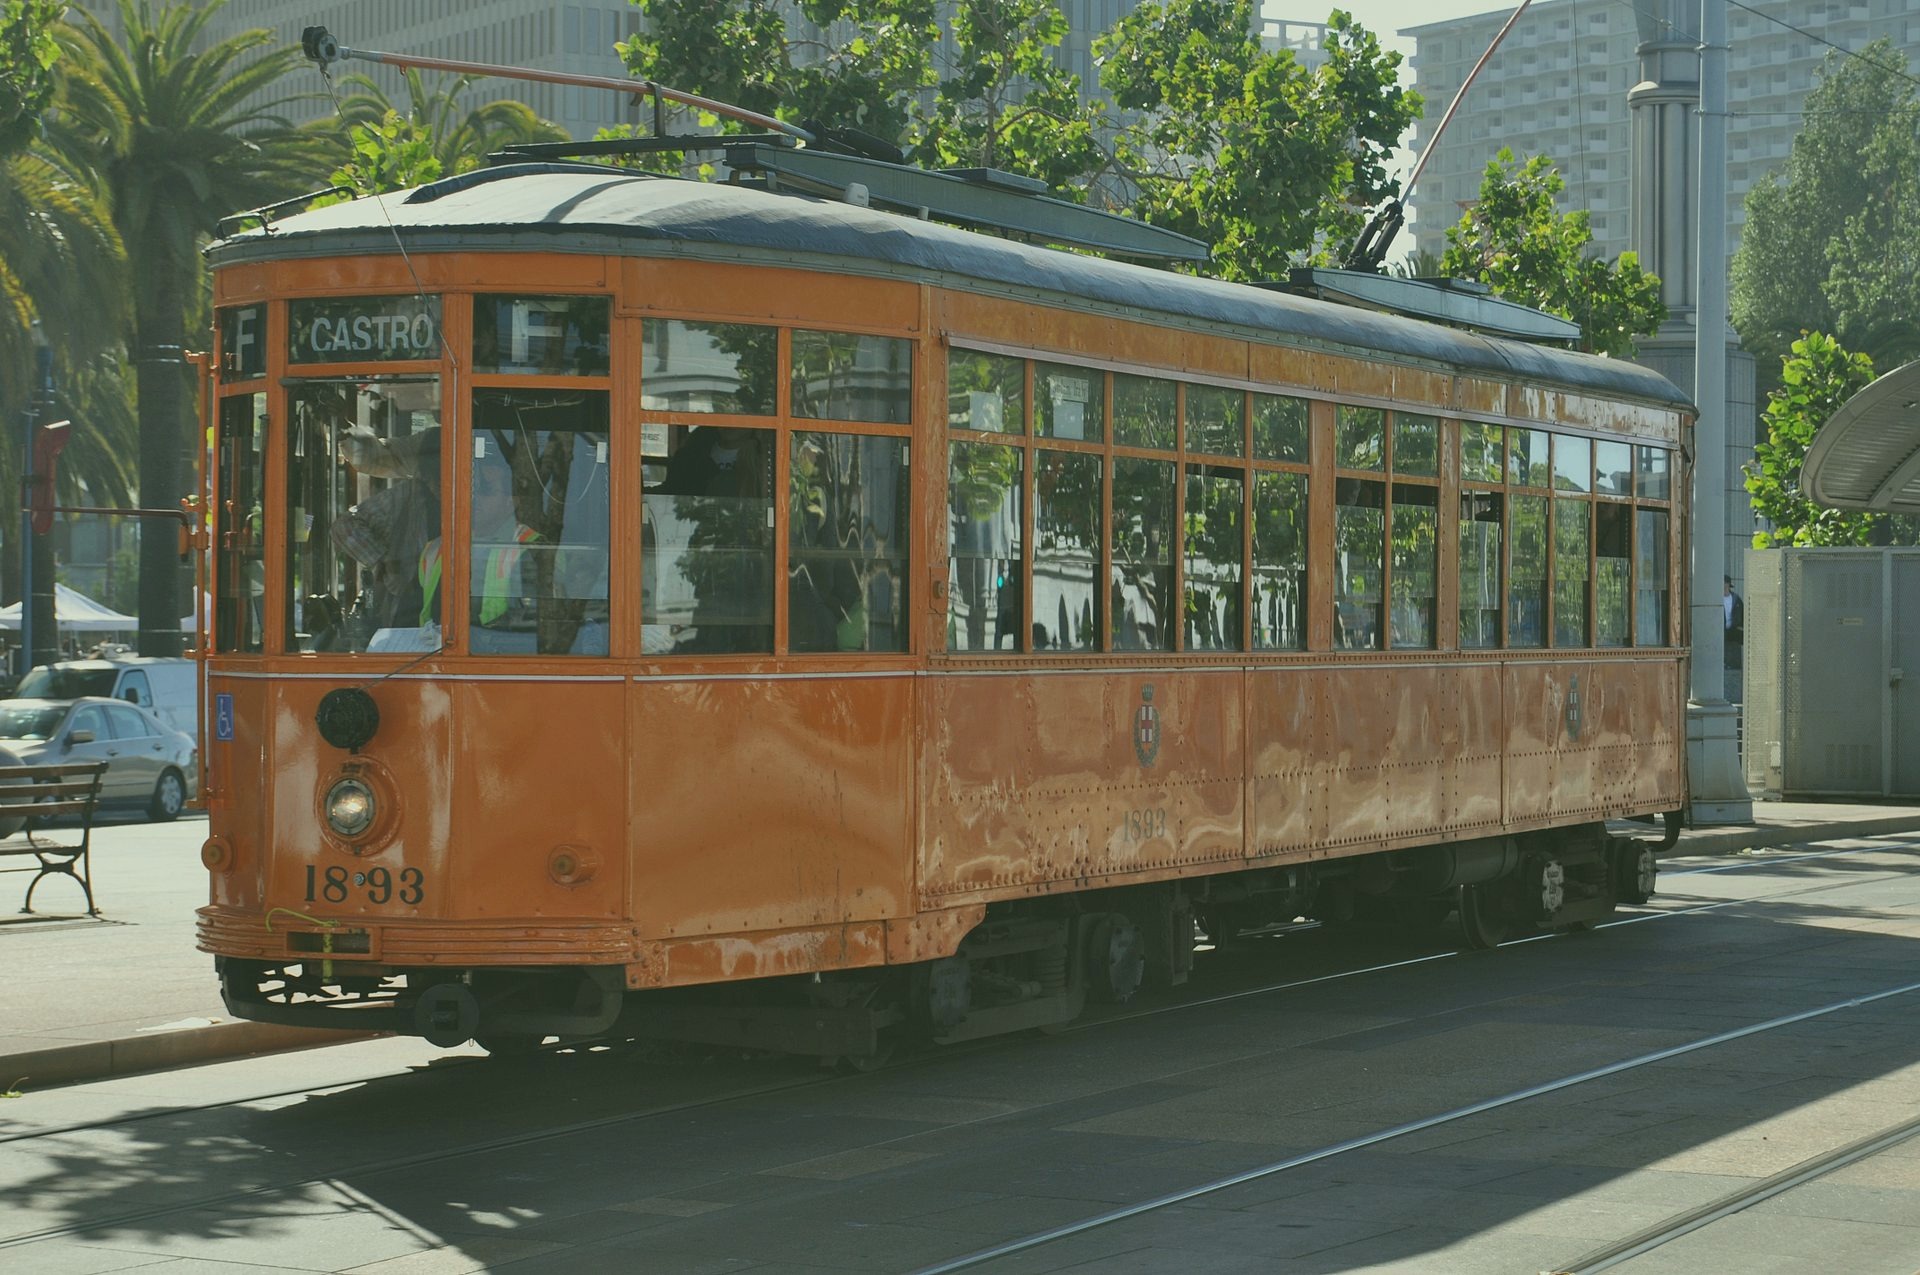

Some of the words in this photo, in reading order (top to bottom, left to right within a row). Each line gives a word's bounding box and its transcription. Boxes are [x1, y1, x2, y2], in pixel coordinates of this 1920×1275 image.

[236, 307, 256, 371] F
[310, 313, 434, 351] CASTRO
[511, 300, 569, 362] F
[1123, 808, 1166, 842] 1893
[304, 865, 424, 904] 1893
